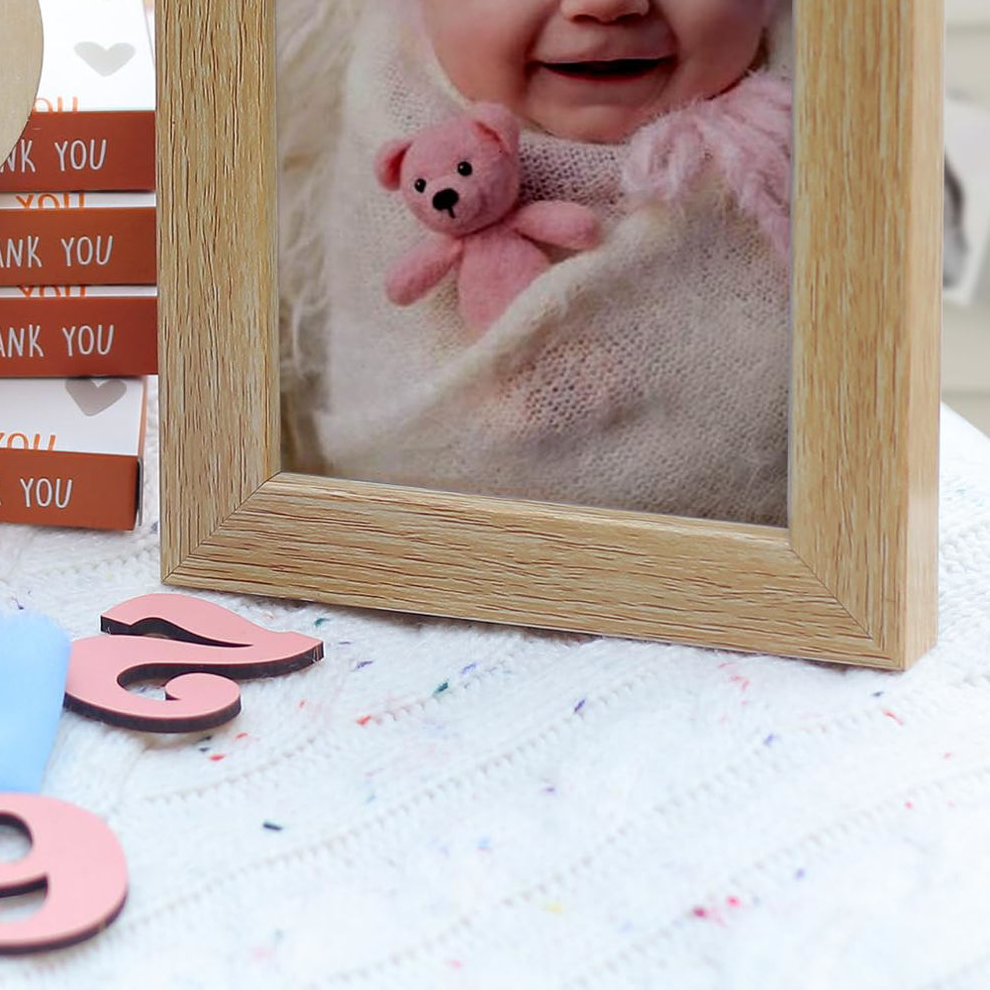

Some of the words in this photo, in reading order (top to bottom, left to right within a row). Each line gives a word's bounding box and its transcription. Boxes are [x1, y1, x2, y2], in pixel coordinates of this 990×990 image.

[54, 139, 107, 171] YOU
[61, 235, 113, 267] YOU
[62, 324, 114, 356] YOU
[20, 478, 73, 508] YOU
